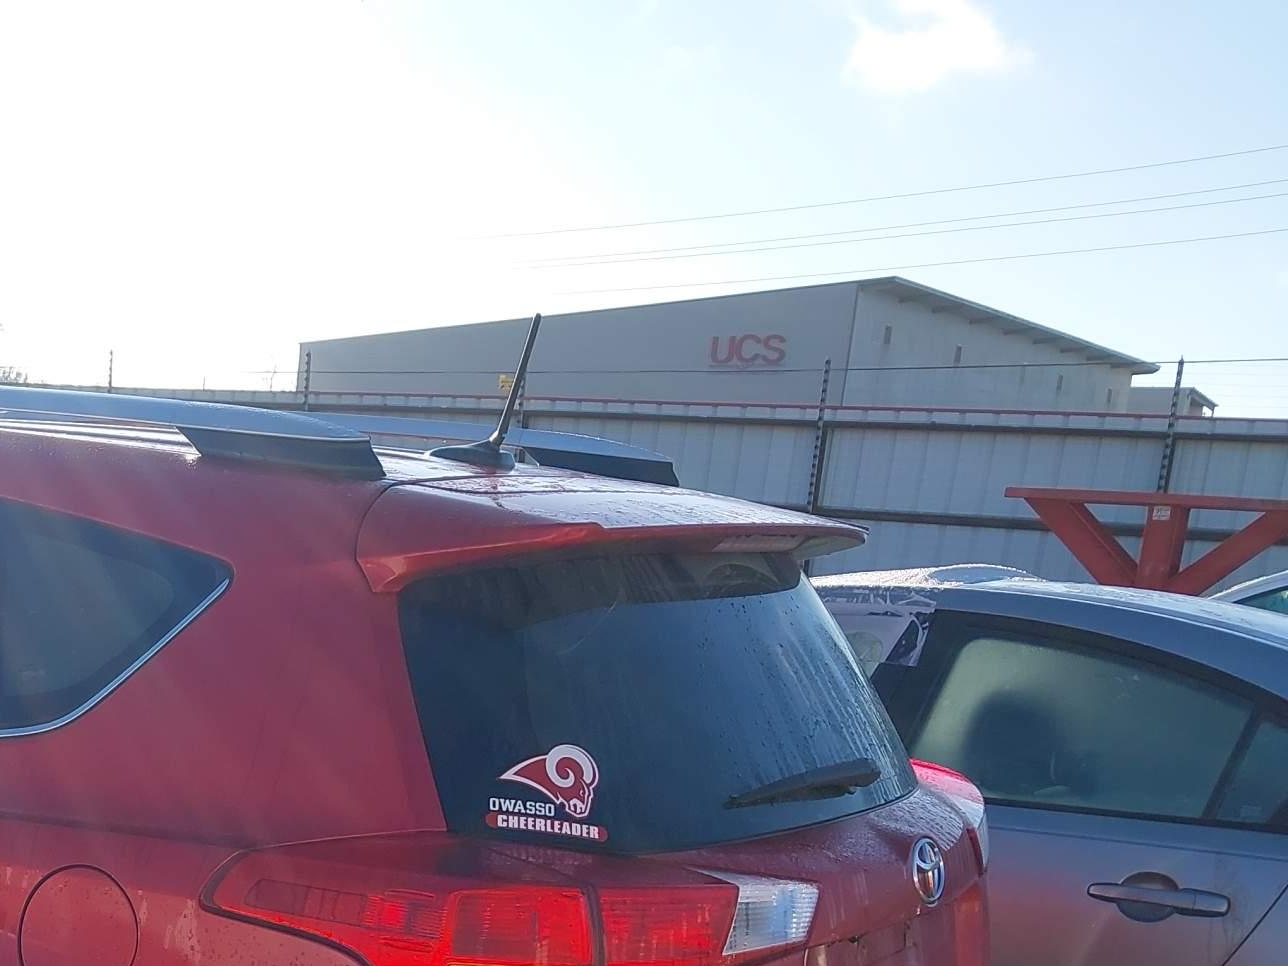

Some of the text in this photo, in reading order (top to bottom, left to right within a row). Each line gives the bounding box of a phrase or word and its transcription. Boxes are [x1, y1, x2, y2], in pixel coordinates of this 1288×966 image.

[710, 334, 786, 365] UCS
[489, 798, 555, 817] OWASSO
[497, 815, 600, 839] CHEERLEADER
